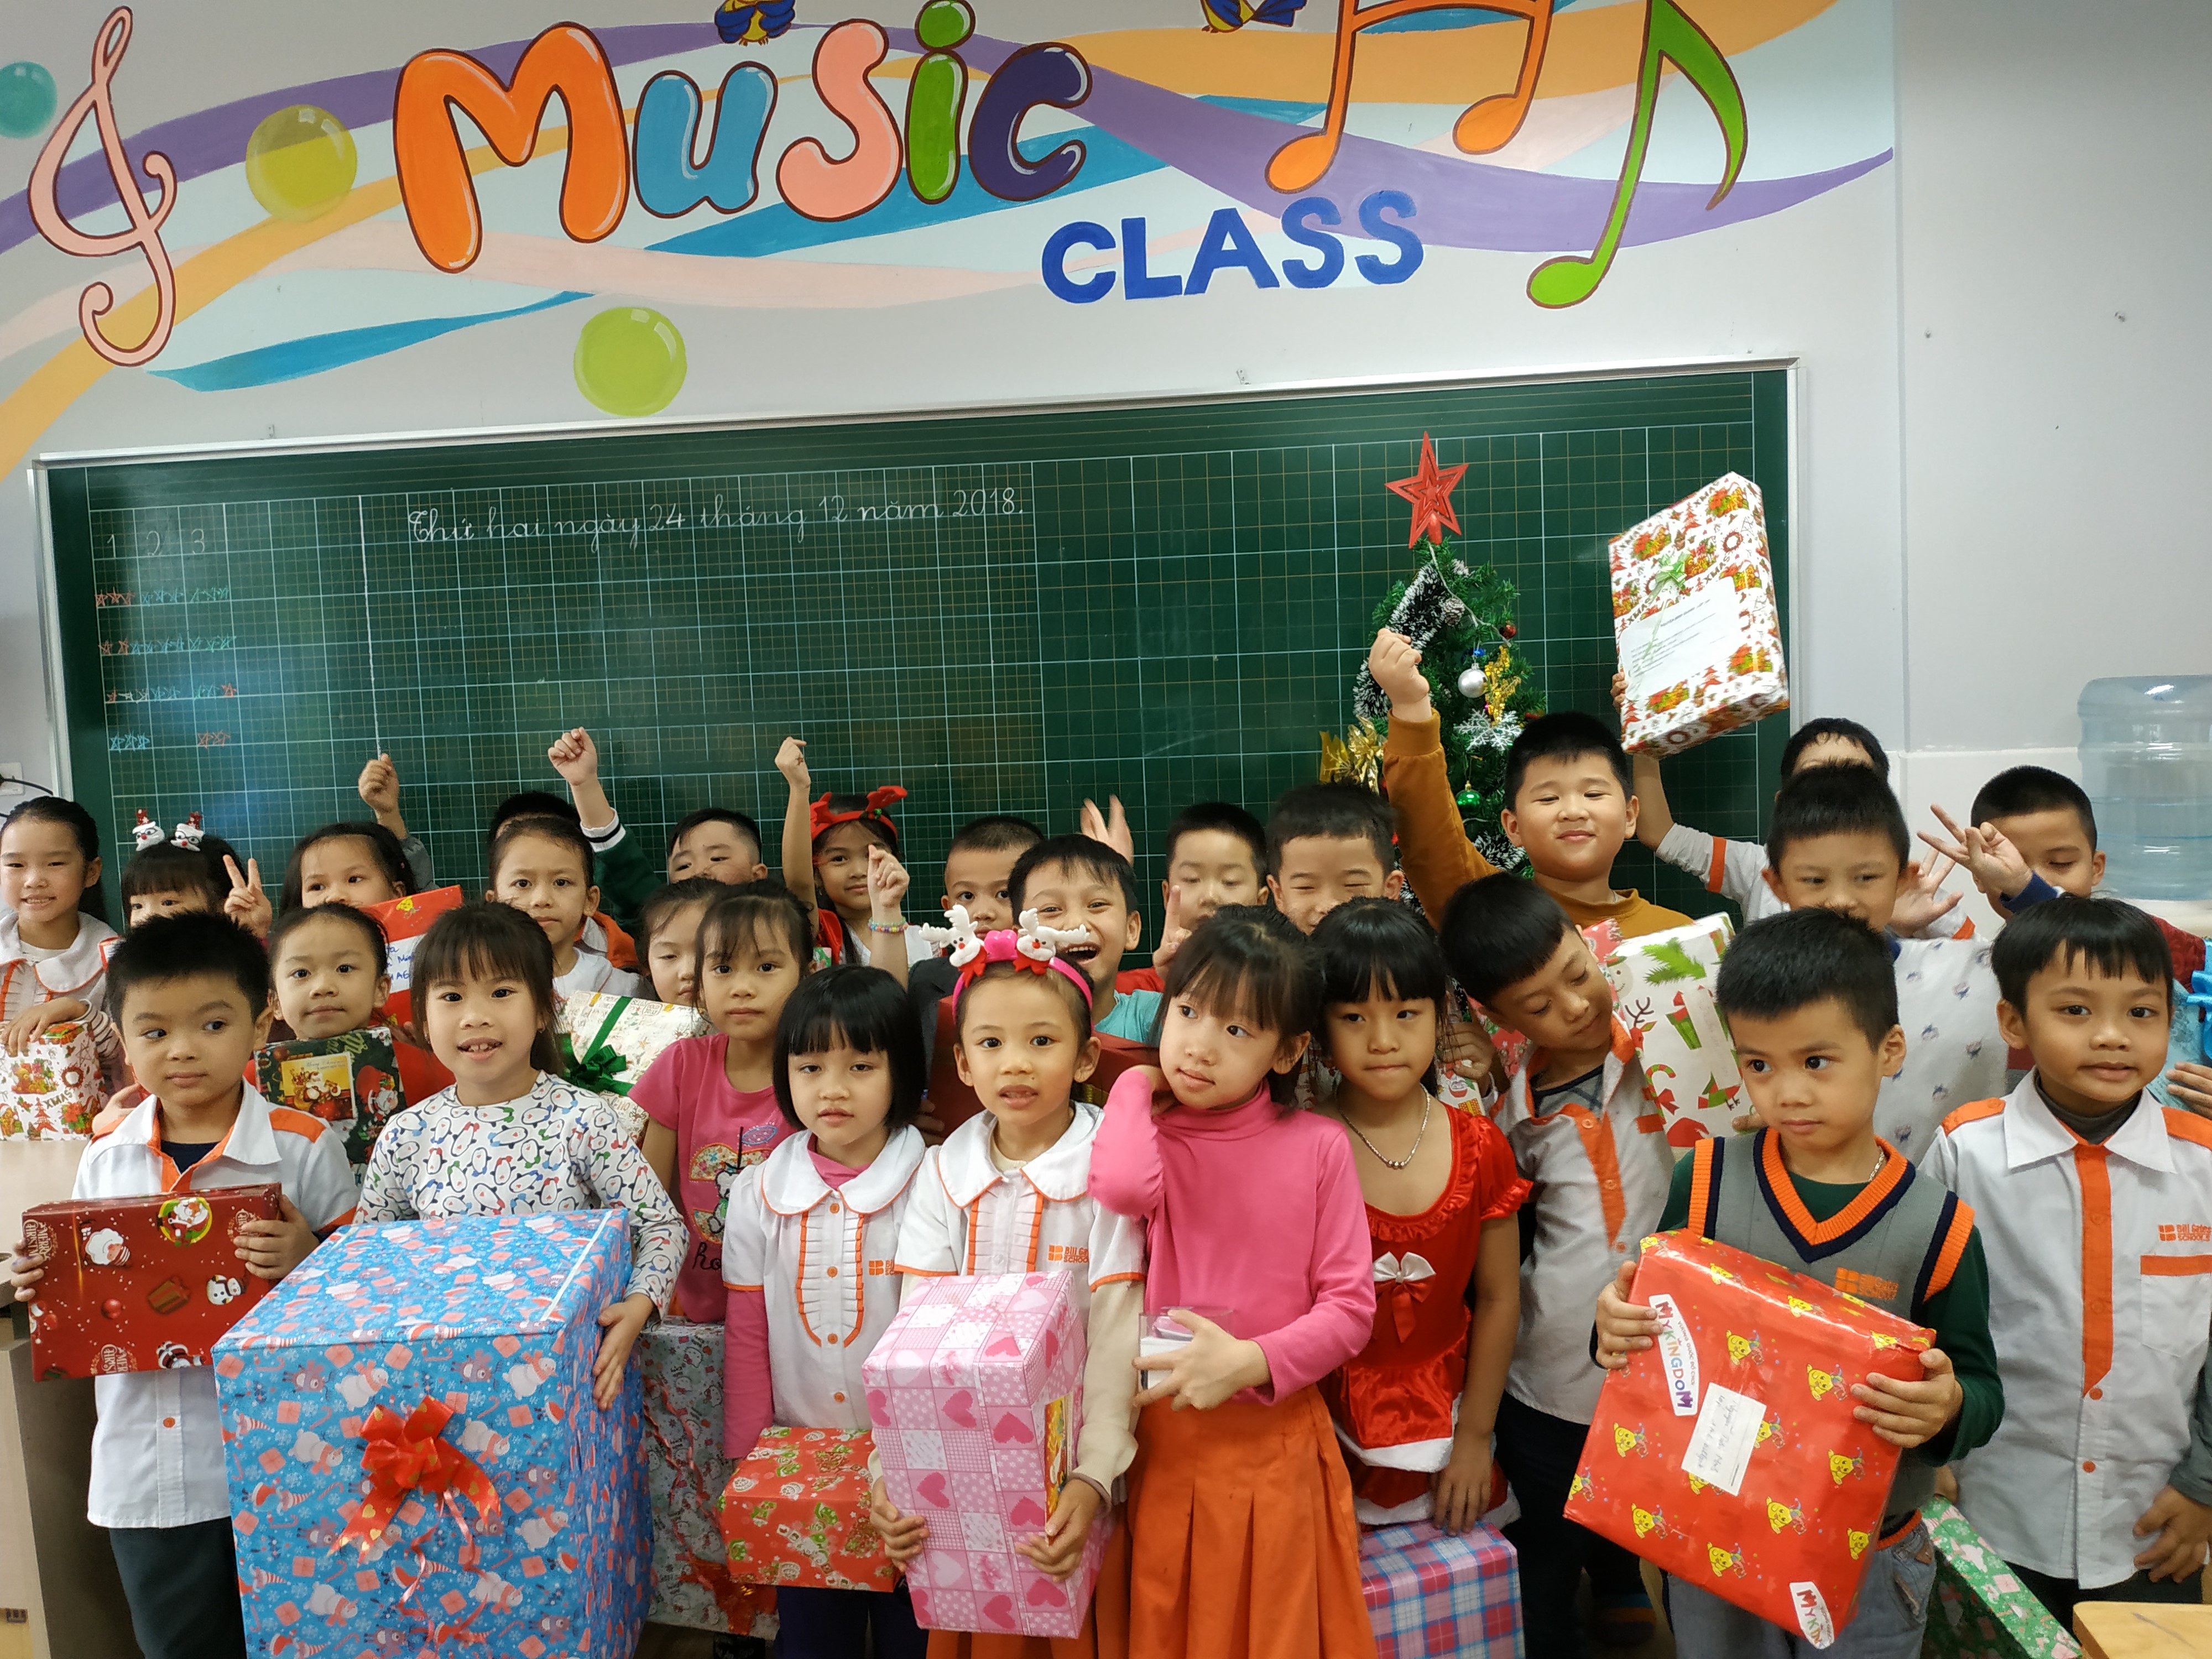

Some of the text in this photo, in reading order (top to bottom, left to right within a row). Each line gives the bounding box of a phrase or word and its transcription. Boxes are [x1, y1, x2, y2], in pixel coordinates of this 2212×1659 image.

[1041, 190, 1425, 304] CLASS
[487, 506, 546, 538] hai
[554, 513, 640, 553] ngày
[649, 503, 686, 531] 24
[700, 494, 807, 544] tháng
[818, 495, 848, 523] 12
[857, 500, 944, 521] năm
[107, 528, 205, 558] 1 2 3
[1703, 555, 1731, 584] XMAS
[43, 1089, 72, 1109] XMAS
[1065, 1246, 1077, 1255] Bill
